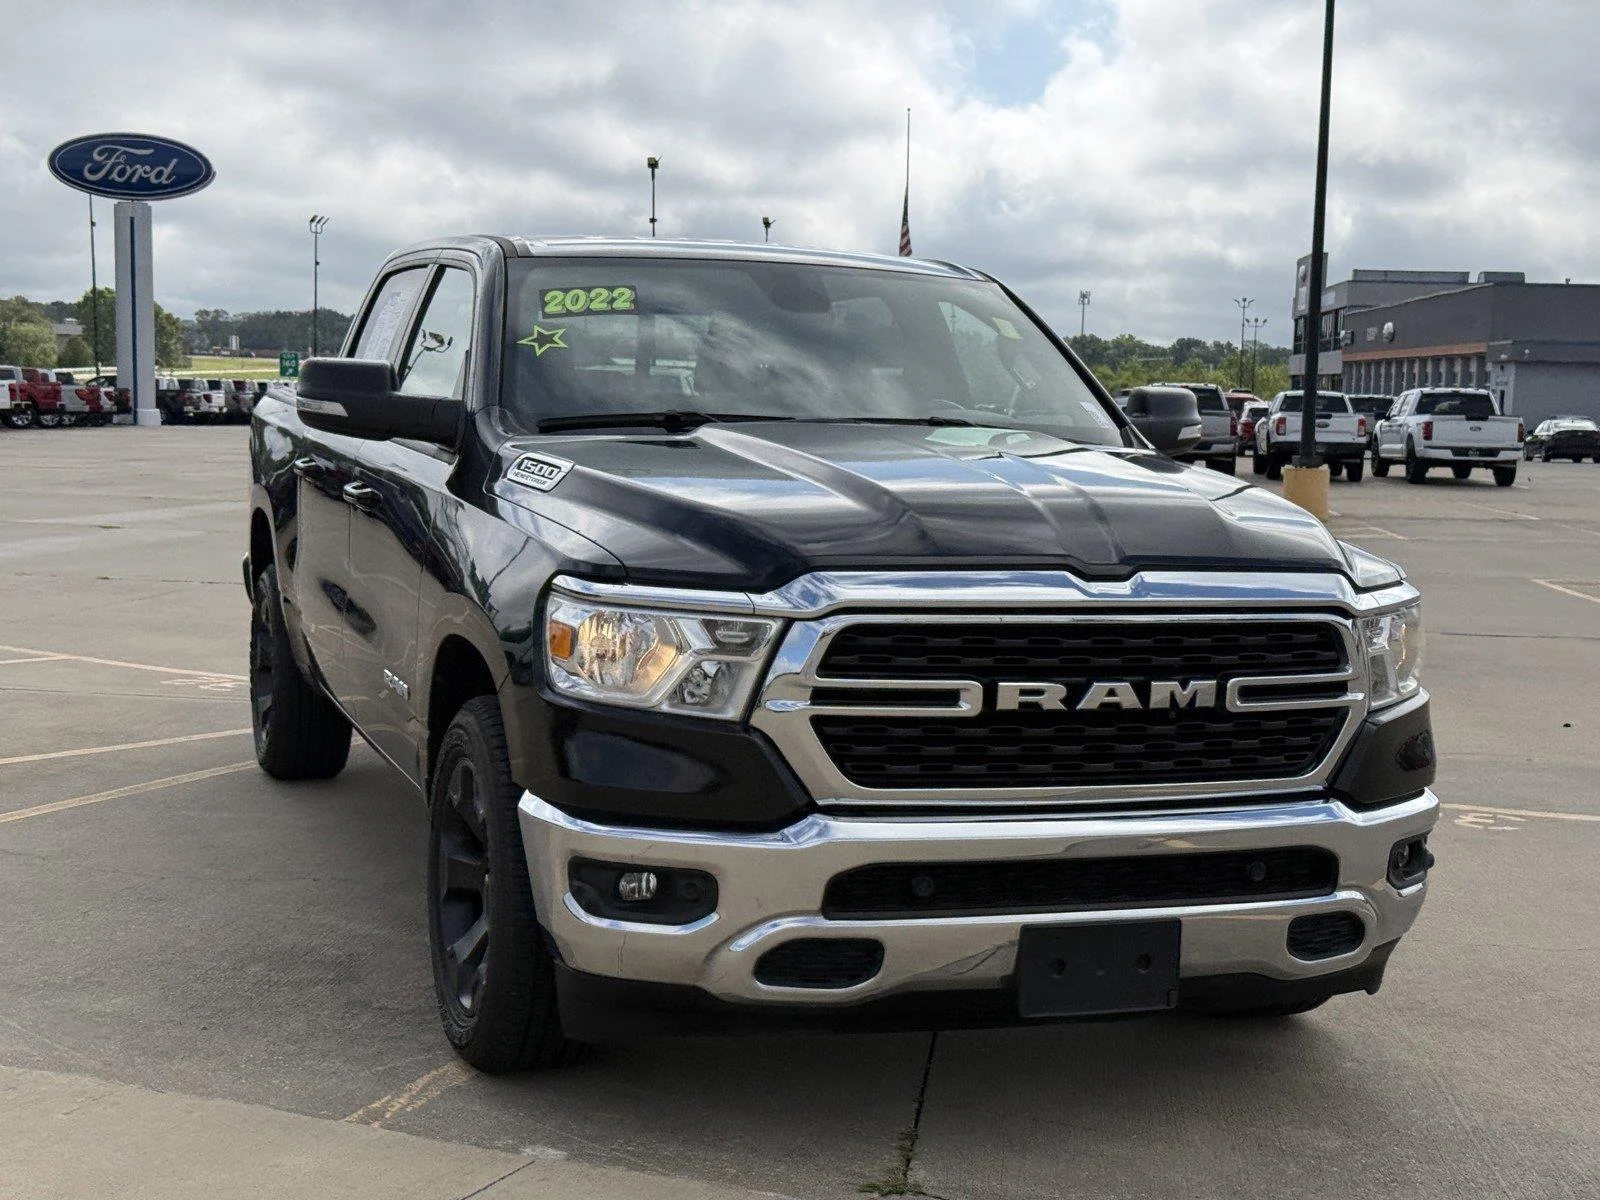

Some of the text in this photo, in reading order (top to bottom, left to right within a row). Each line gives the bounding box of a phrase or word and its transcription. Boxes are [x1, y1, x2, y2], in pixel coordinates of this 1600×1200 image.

[83, 144, 178, 185] Ford
[544, 287, 635, 315] 2022
[520, 459, 560, 479] 1500
[995, 680, 1217, 712] RAM
